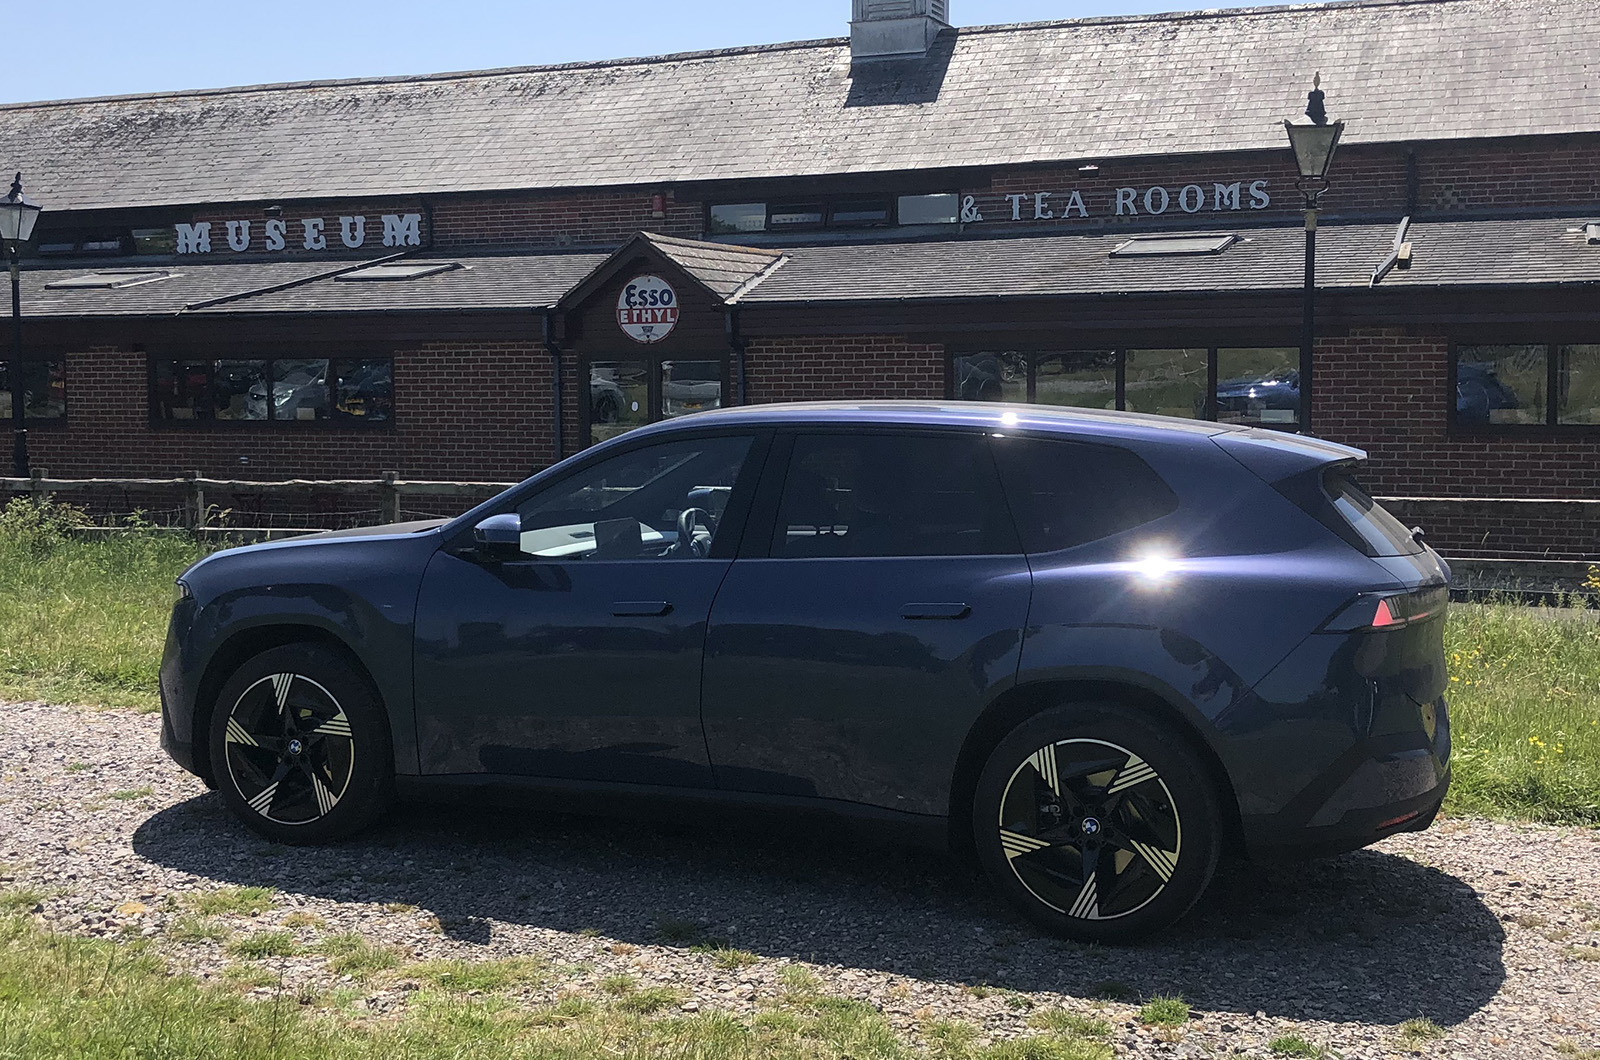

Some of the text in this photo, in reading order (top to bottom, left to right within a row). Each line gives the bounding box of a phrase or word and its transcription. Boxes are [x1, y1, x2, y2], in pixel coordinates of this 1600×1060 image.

[960, 180, 1270, 223] & TEA ROOMS
[175, 213, 422, 254] MUSEUM
[620, 309, 675, 323] ETHYL
